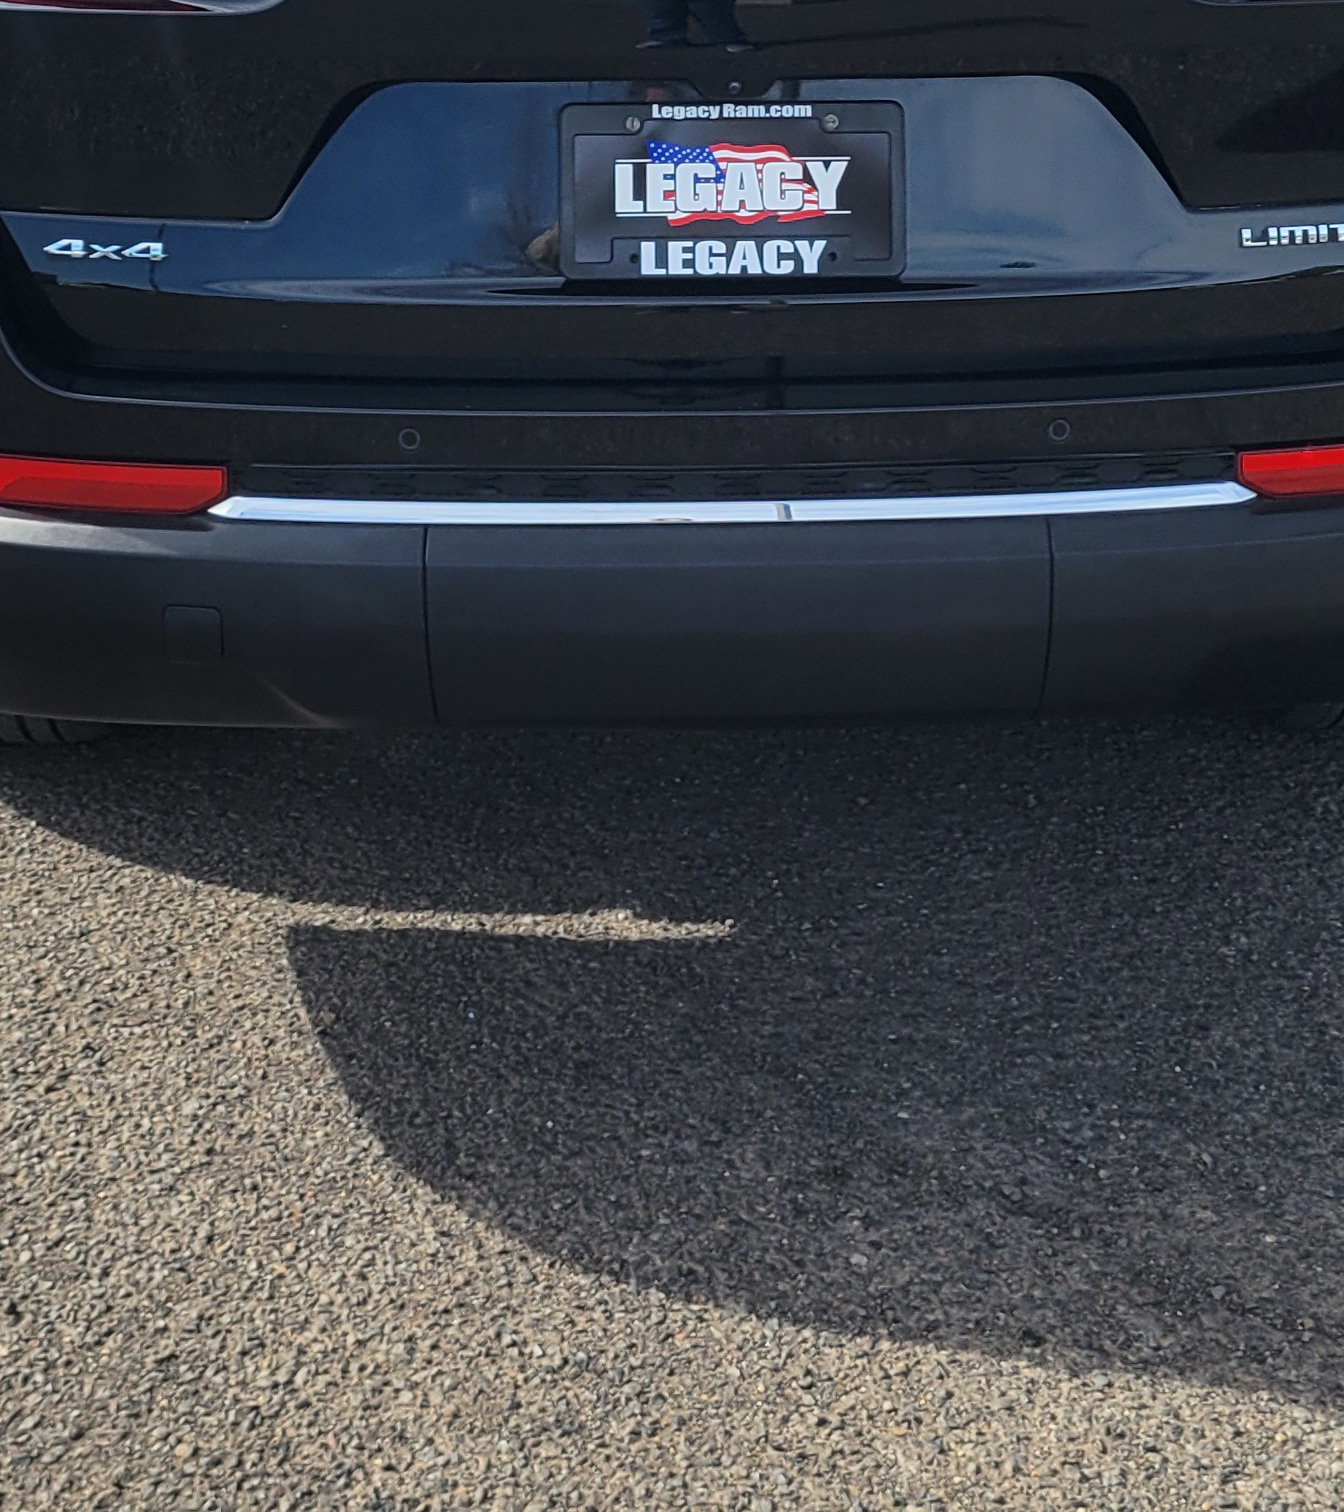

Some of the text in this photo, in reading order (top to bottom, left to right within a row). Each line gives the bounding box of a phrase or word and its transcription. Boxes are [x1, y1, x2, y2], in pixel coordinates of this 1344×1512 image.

[652, 103, 813, 119] Legacy Ram.com
[614, 161, 849, 213] LEGACY
[42, 238, 169, 261] 4x4
[640, 240, 827, 275] LEGACY
